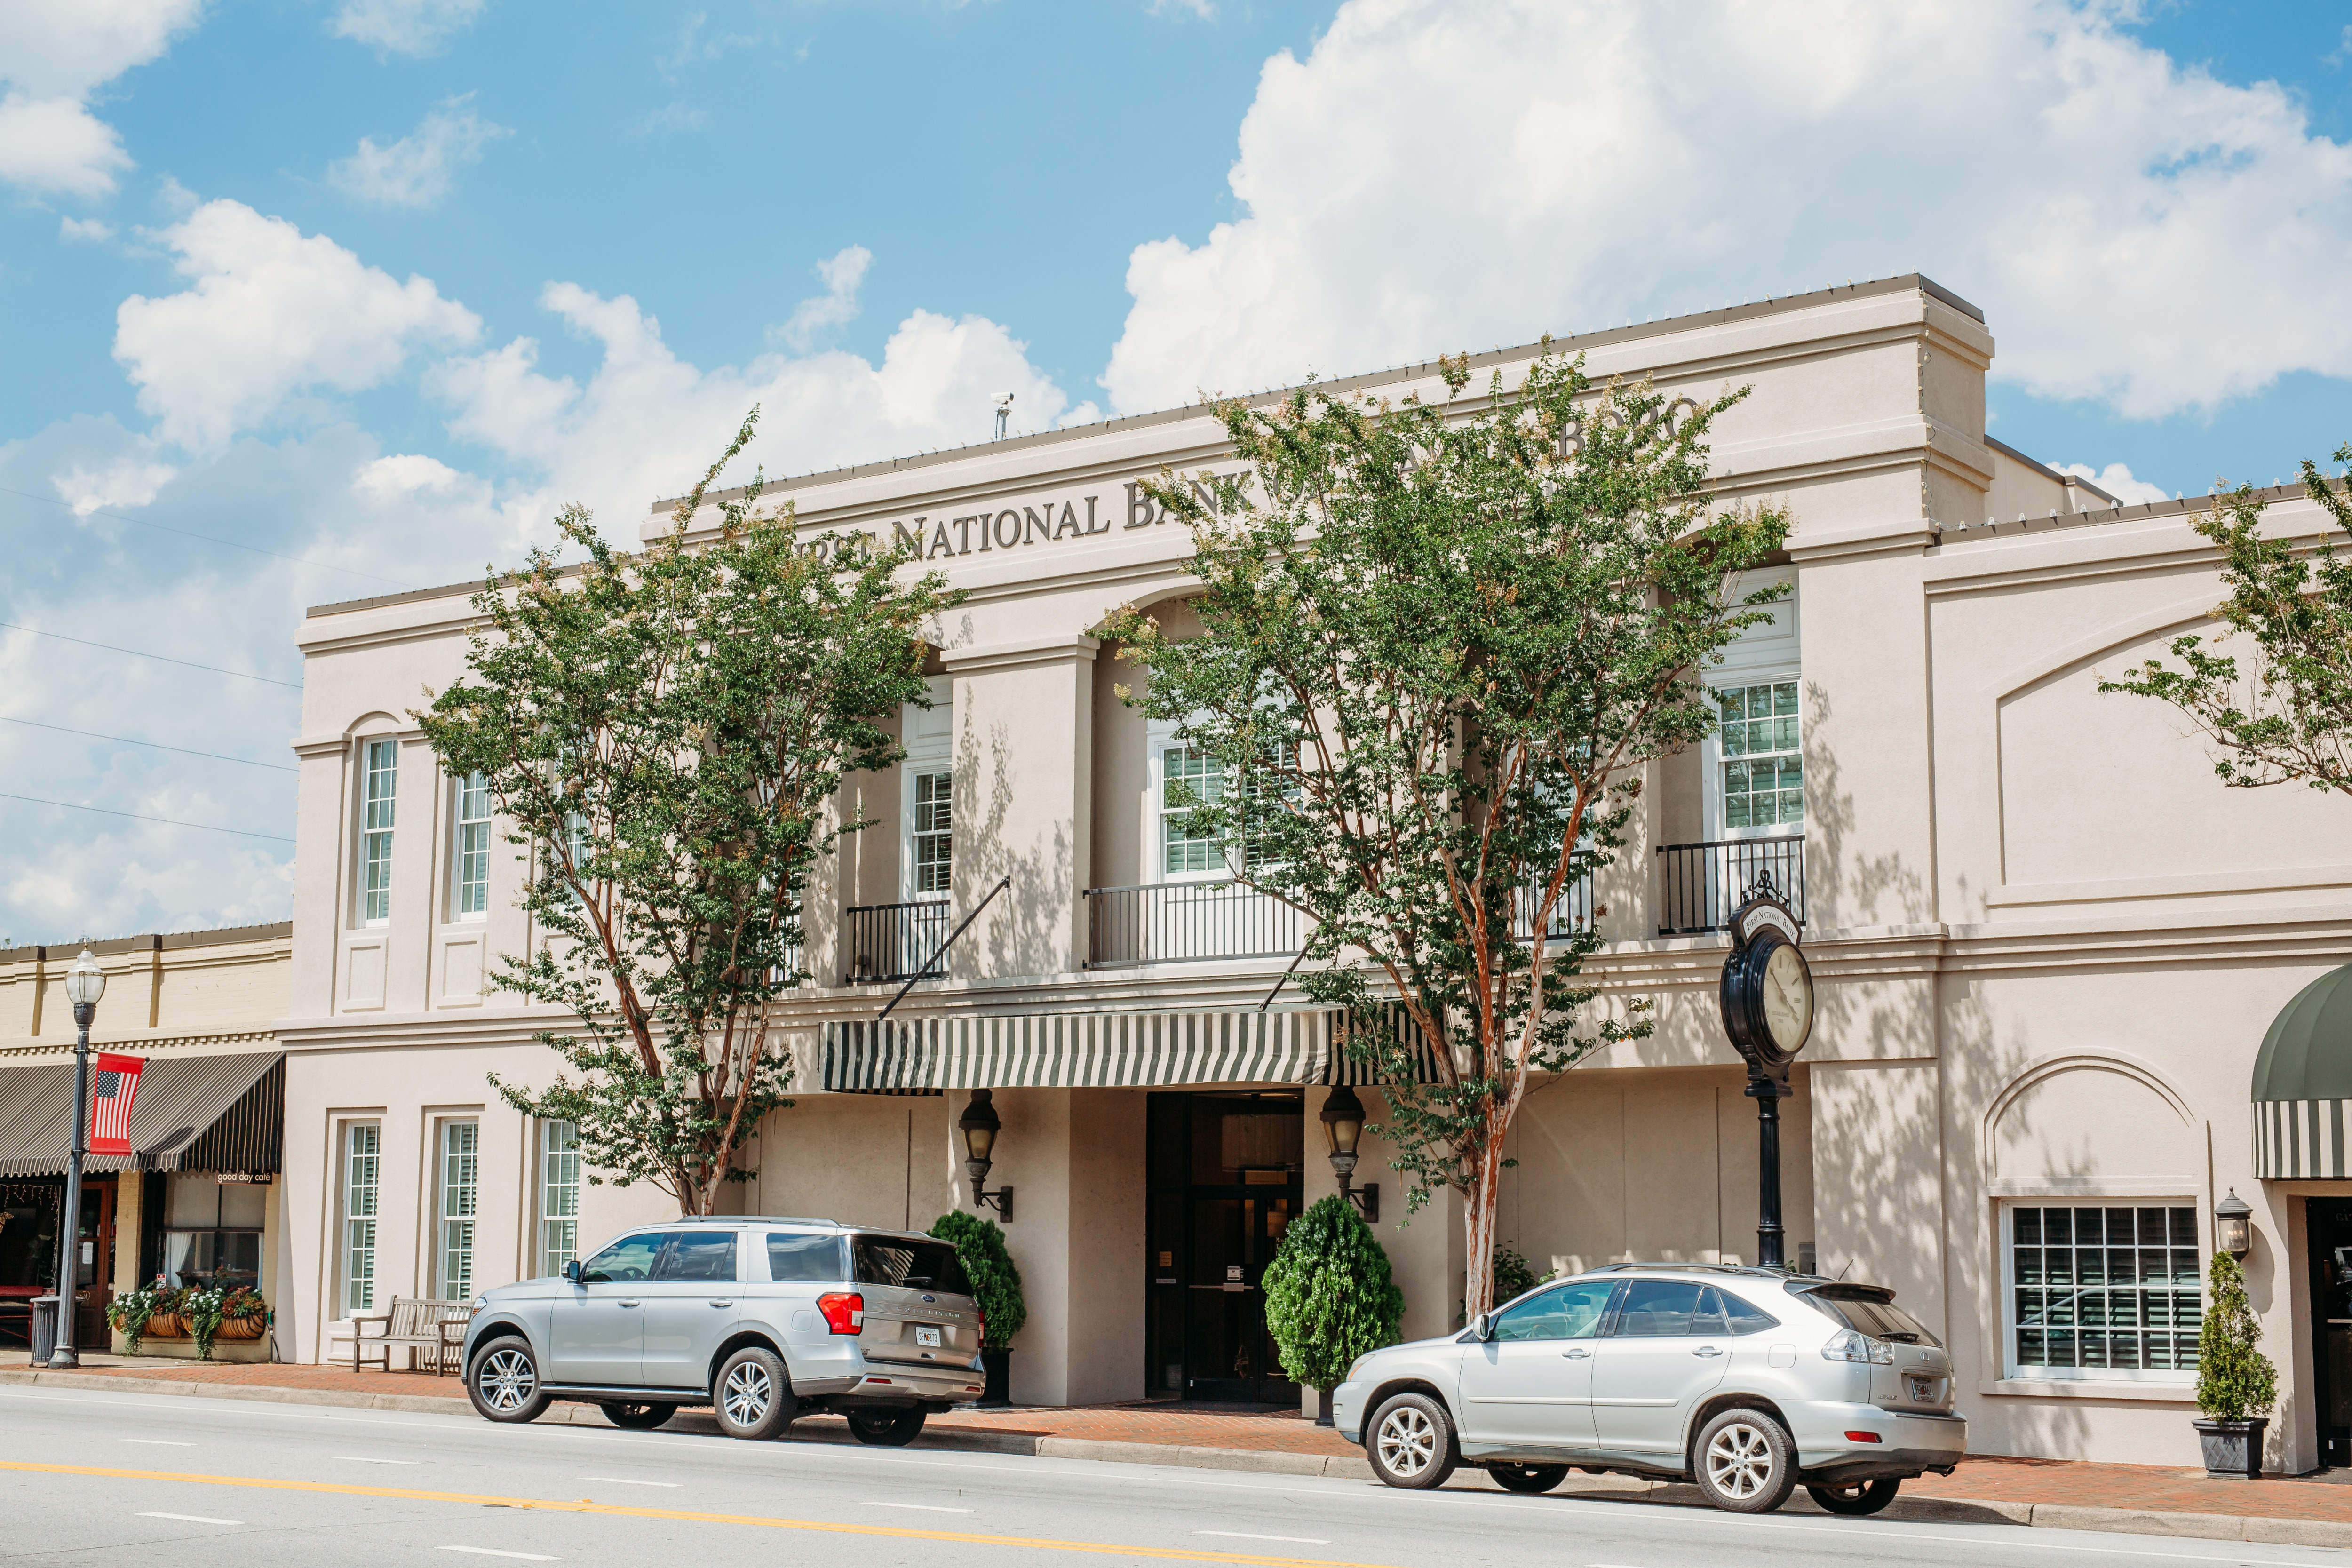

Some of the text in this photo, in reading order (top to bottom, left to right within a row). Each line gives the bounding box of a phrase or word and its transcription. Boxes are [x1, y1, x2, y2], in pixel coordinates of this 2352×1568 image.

[891, 495, 1111, 563] NATIONAL
[1746, 910, 1795, 939] FIRST NATIONAL BANK
[218, 1173, 237, 1183] good
[239, 1170, 253, 1184] day
[1741, 1415, 1777, 1447] GOODYEAR
[1700, 1477, 1735, 1507] ASSURANCE
